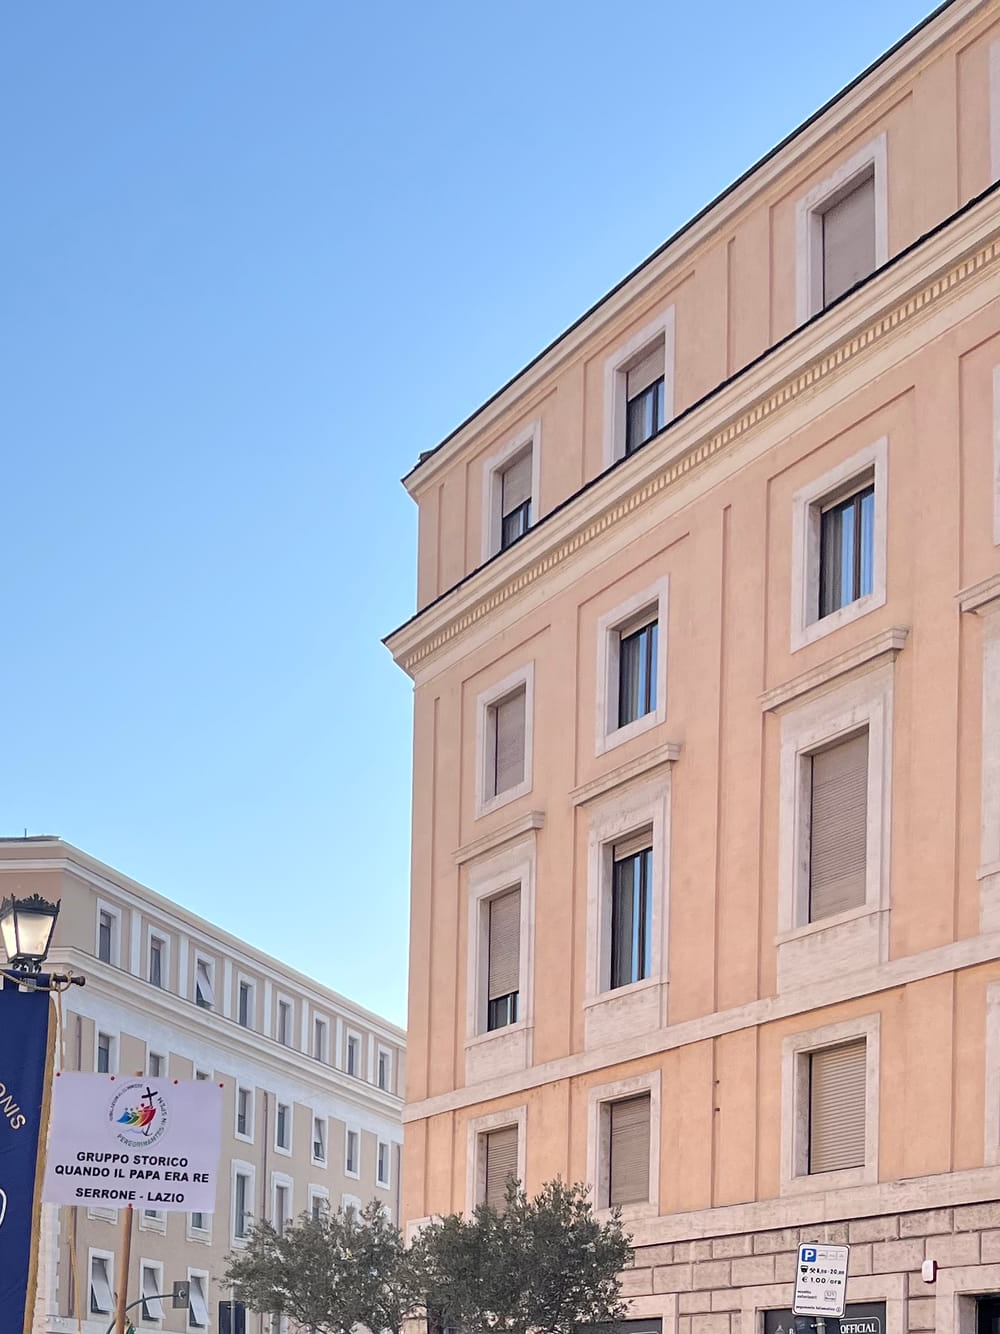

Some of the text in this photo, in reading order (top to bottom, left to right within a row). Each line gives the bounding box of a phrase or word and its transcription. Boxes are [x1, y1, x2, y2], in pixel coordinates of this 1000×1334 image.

[76, 1152, 188, 1167] GRUPPO STORICO
[55, 1165, 209, 1183] QUANDO IL PAPA ERA RE
[75, 1187, 136, 1200] SERRONE
[147, 1191, 185, 1203] LAZIO
[840, 1323, 877, 1334] OFFICIAL
